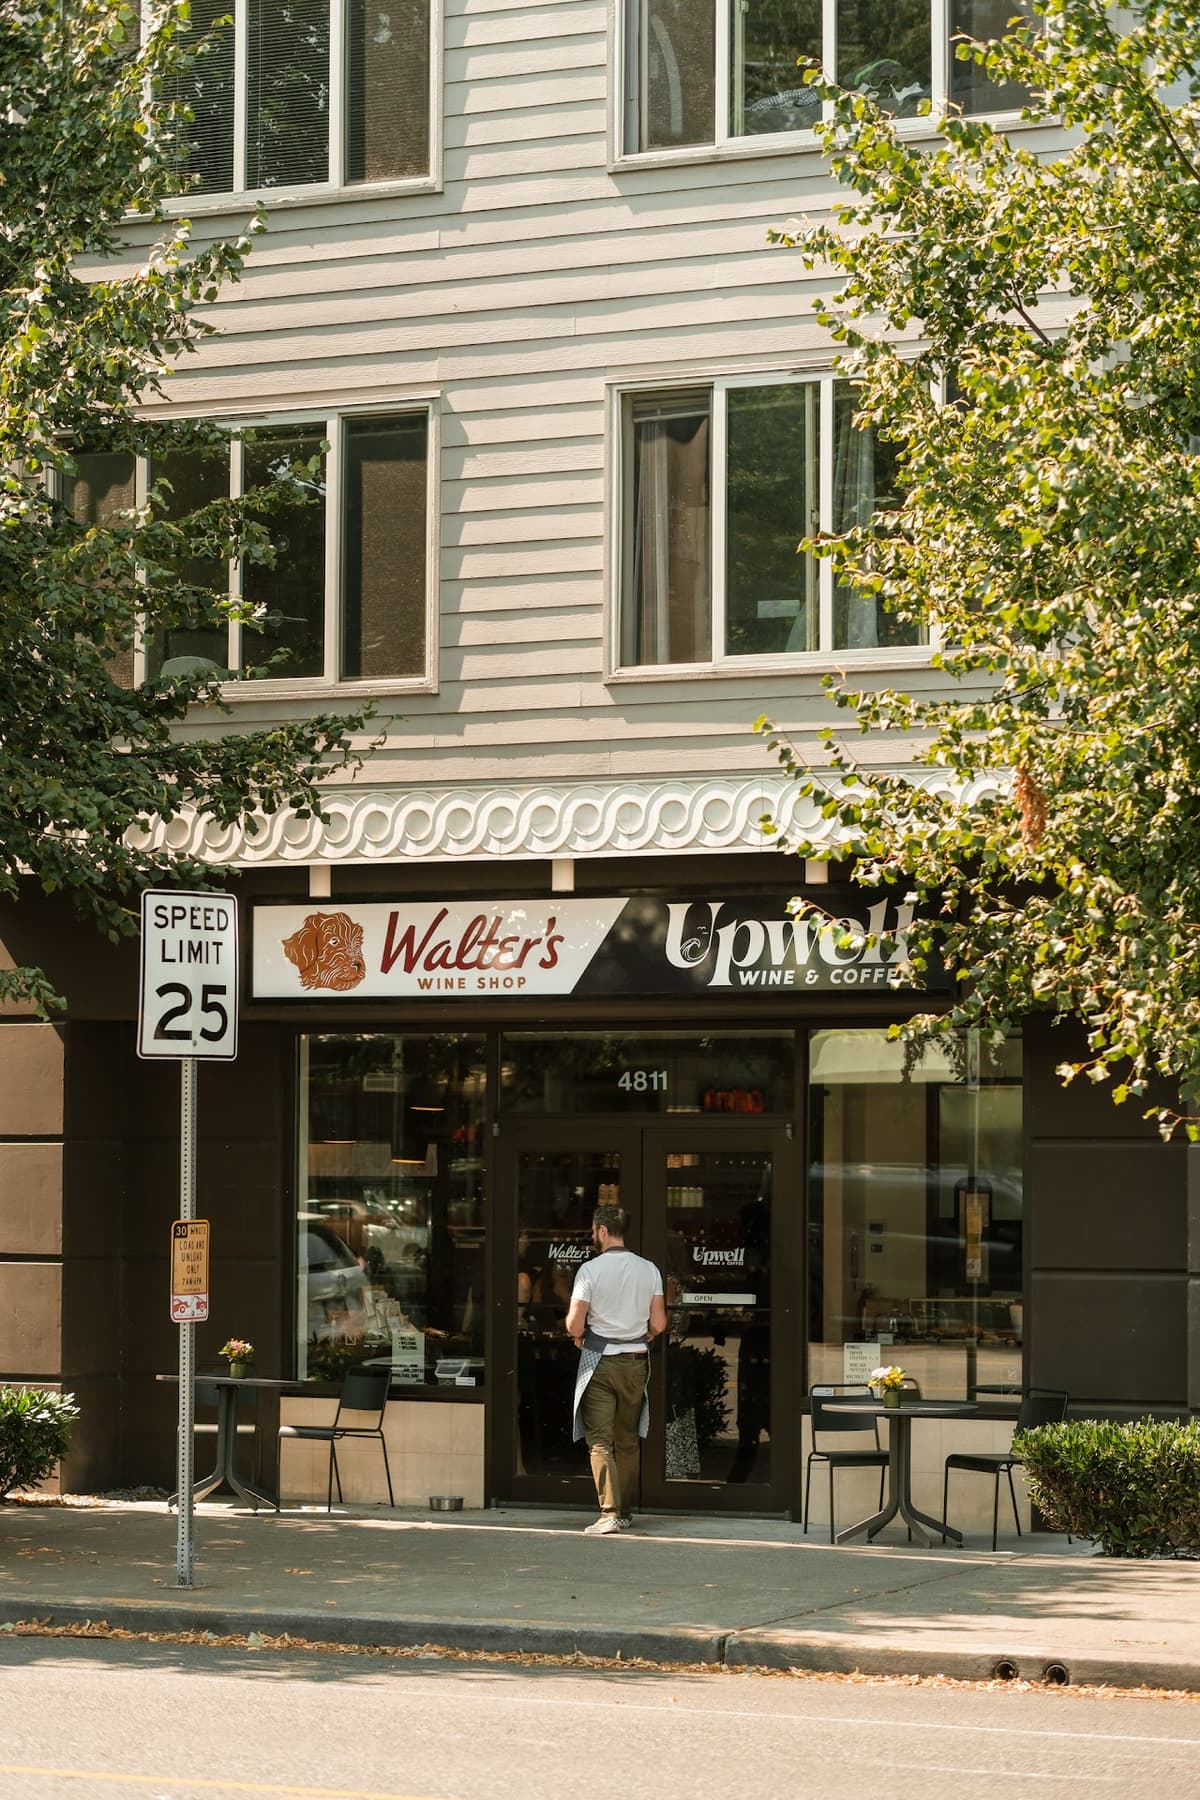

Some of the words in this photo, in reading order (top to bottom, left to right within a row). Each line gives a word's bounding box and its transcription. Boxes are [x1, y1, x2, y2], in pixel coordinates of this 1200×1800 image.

[154, 905, 229, 931] SPEED
[380, 907, 565, 974] Walter's
[665, 897, 914, 986] Upwell
[161, 939, 223, 965] LIMIT
[417, 978, 466, 990] WINE
[477, 976, 526, 989] SHOP
[739, 970, 795, 985] WINE
[805, 970, 819, 984] &
[830, 968, 911, 984] COFFE
[153, 982, 229, 1042] 25
[617, 1070, 668, 1091] 4811
[175, 1226, 187, 1236] 30
[548, 1243, 591, 1259] Walter's
[693, 1246, 745, 1266] Upwell
[186, 1265, 200, 1274] ONLY
